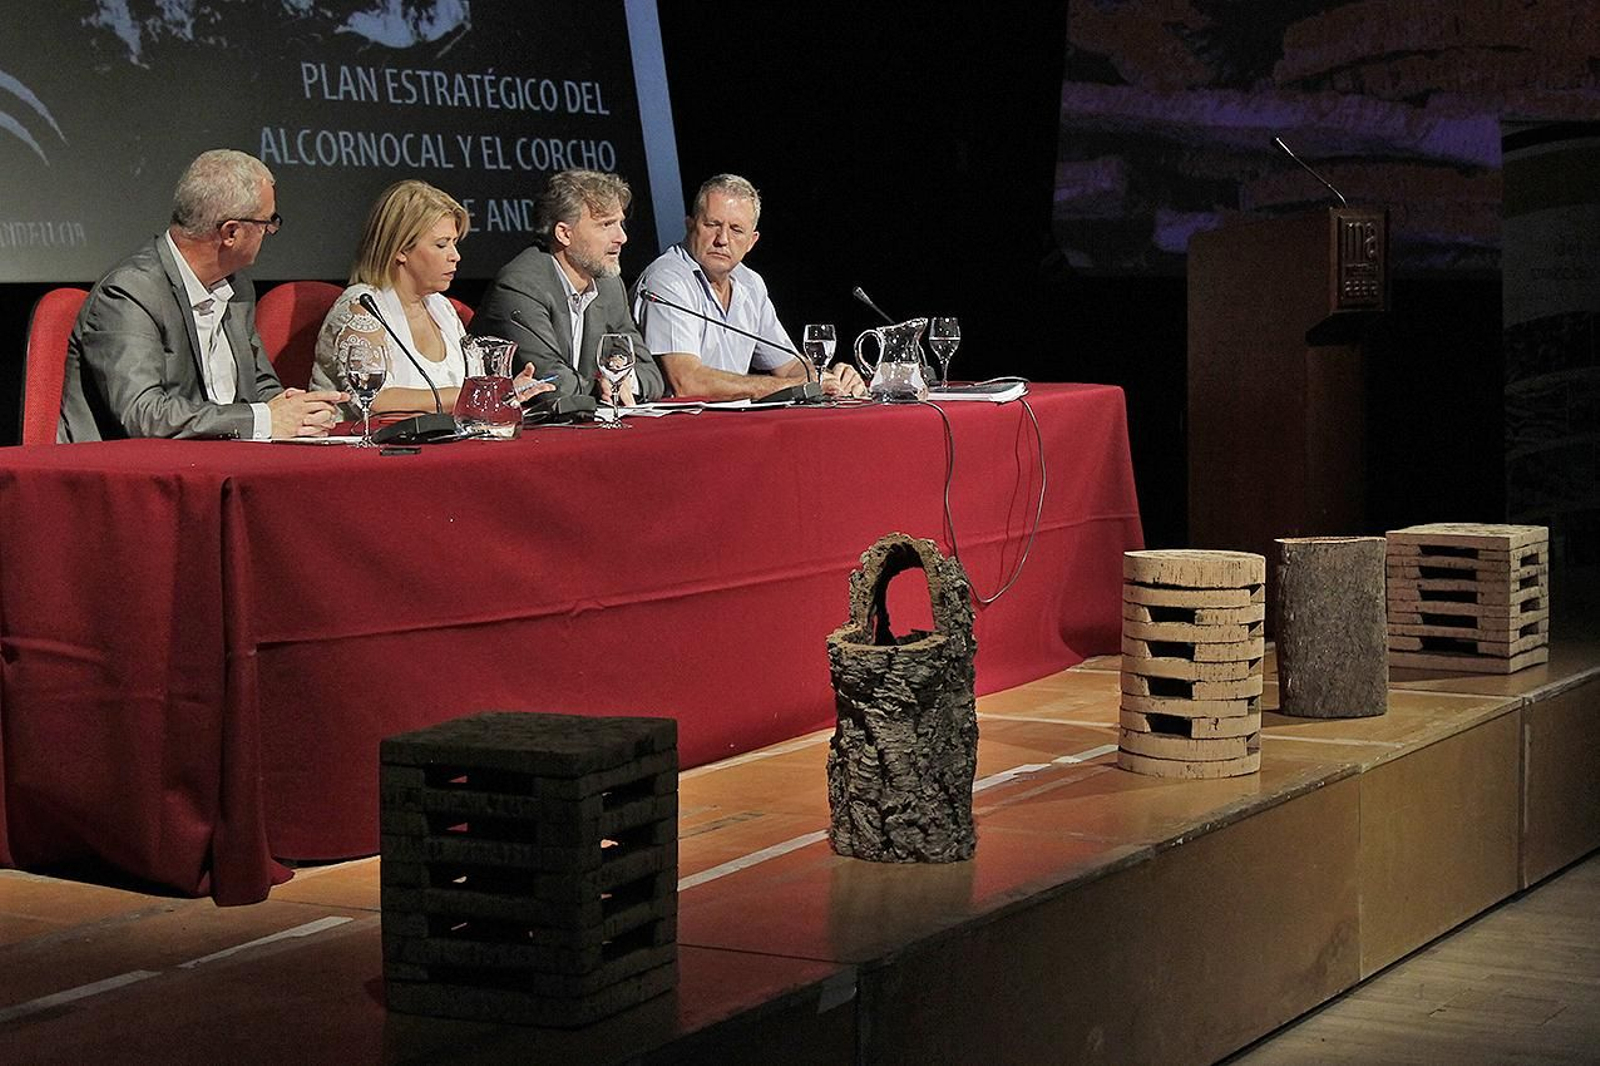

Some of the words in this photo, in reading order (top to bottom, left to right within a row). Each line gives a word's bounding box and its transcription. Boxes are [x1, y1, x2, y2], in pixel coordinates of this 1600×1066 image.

[301, 62, 378, 102] PLAN
[386, 68, 559, 112] ESTRATÉGICO
[564, 81, 610, 116] DEL
[260, 127, 453, 169] ALCORNOCAL
[457, 135, 473, 168] Y
[481, 137, 512, 170] EL
[516, 138, 617, 172] CORCHO
